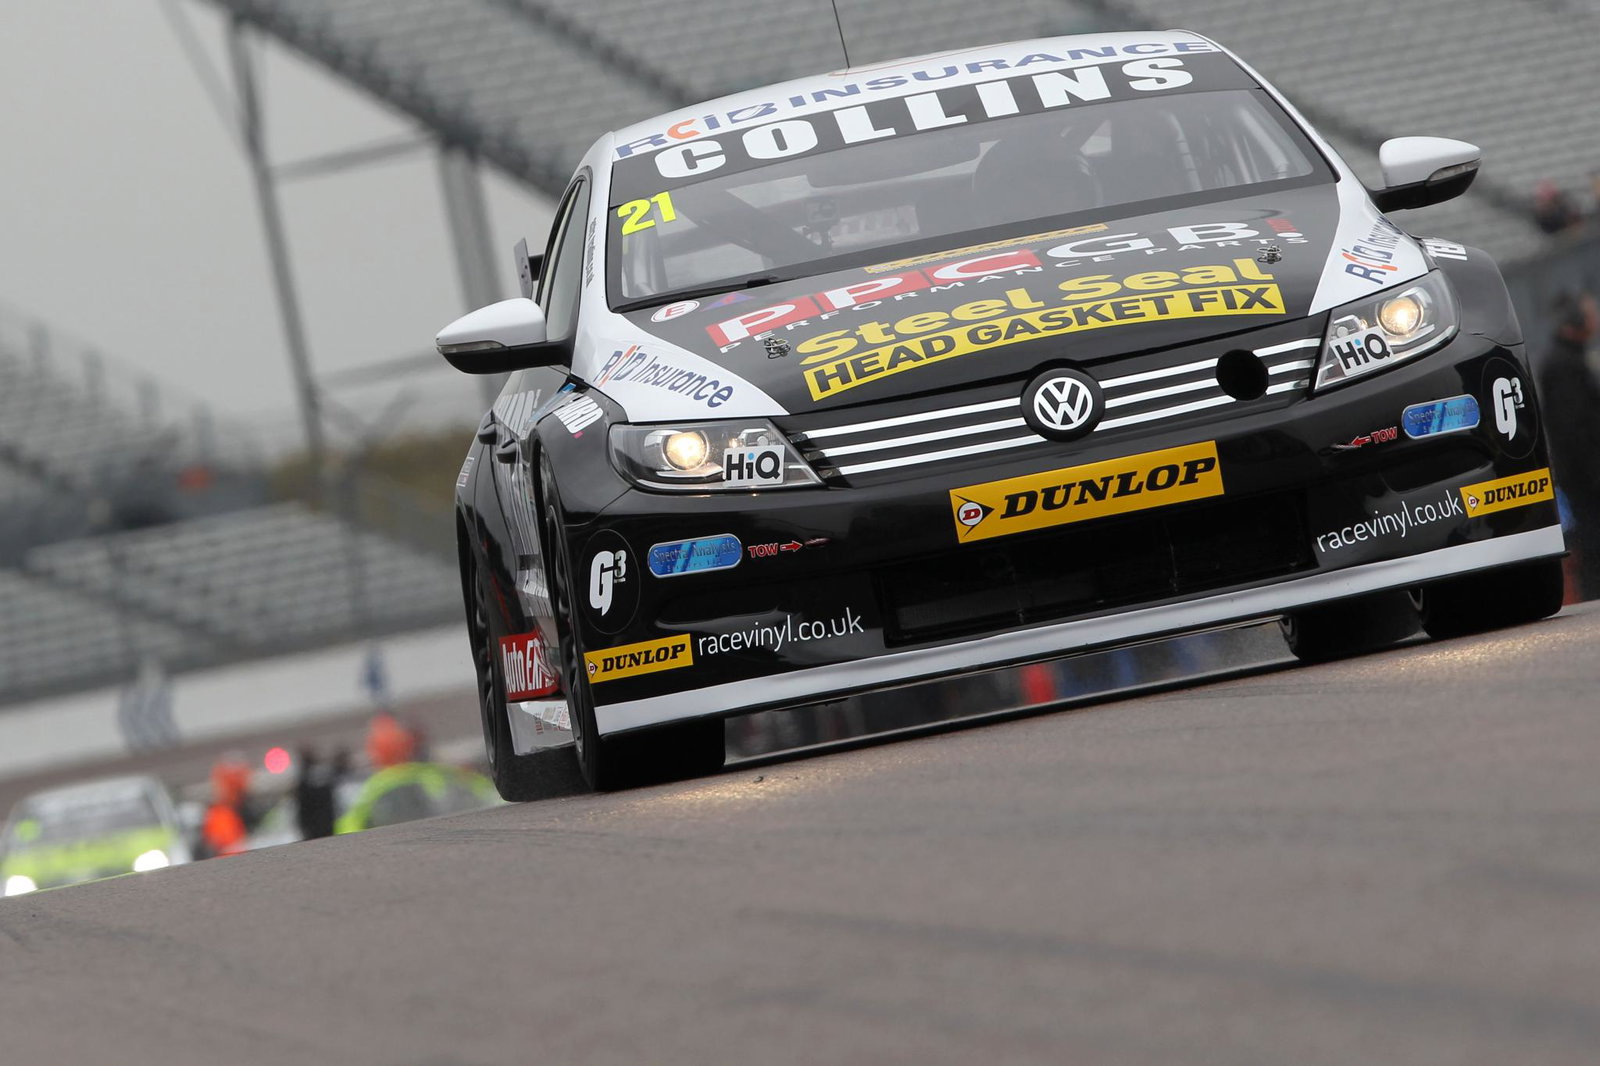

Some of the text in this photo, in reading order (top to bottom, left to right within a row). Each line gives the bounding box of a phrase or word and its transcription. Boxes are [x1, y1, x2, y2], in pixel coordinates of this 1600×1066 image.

[789, 42, 1214, 108] INSURANCE
[654, 57, 1193, 178] COLLINS
[617, 191, 676, 236] 21
[719, 254, 1115, 354] PERFORMANCE
[1145, 236, 1309, 255] PARTS
[796, 258, 1274, 365] Steel seal
[813, 287, 1278, 393] HEAD GASKET FIX
[1337, 333, 1391, 370] HiQ
[629, 355, 734, 408] Insurance
[1034, 377, 1094, 430] VW
[1371, 427, 1397, 443] TOW
[726, 450, 781, 481] HiQ
[1000, 457, 1217, 520] DUNLOP
[1483, 478, 1549, 506] DUNLOP
[1316, 490, 1464, 552] racevinyl.co.uk
[748, 543, 778, 558] TOW
[601, 643, 686, 673] DUNLOP
[698, 607, 864, 657] racevinyl.co.uk
[502, 640, 526, 694] Auto
